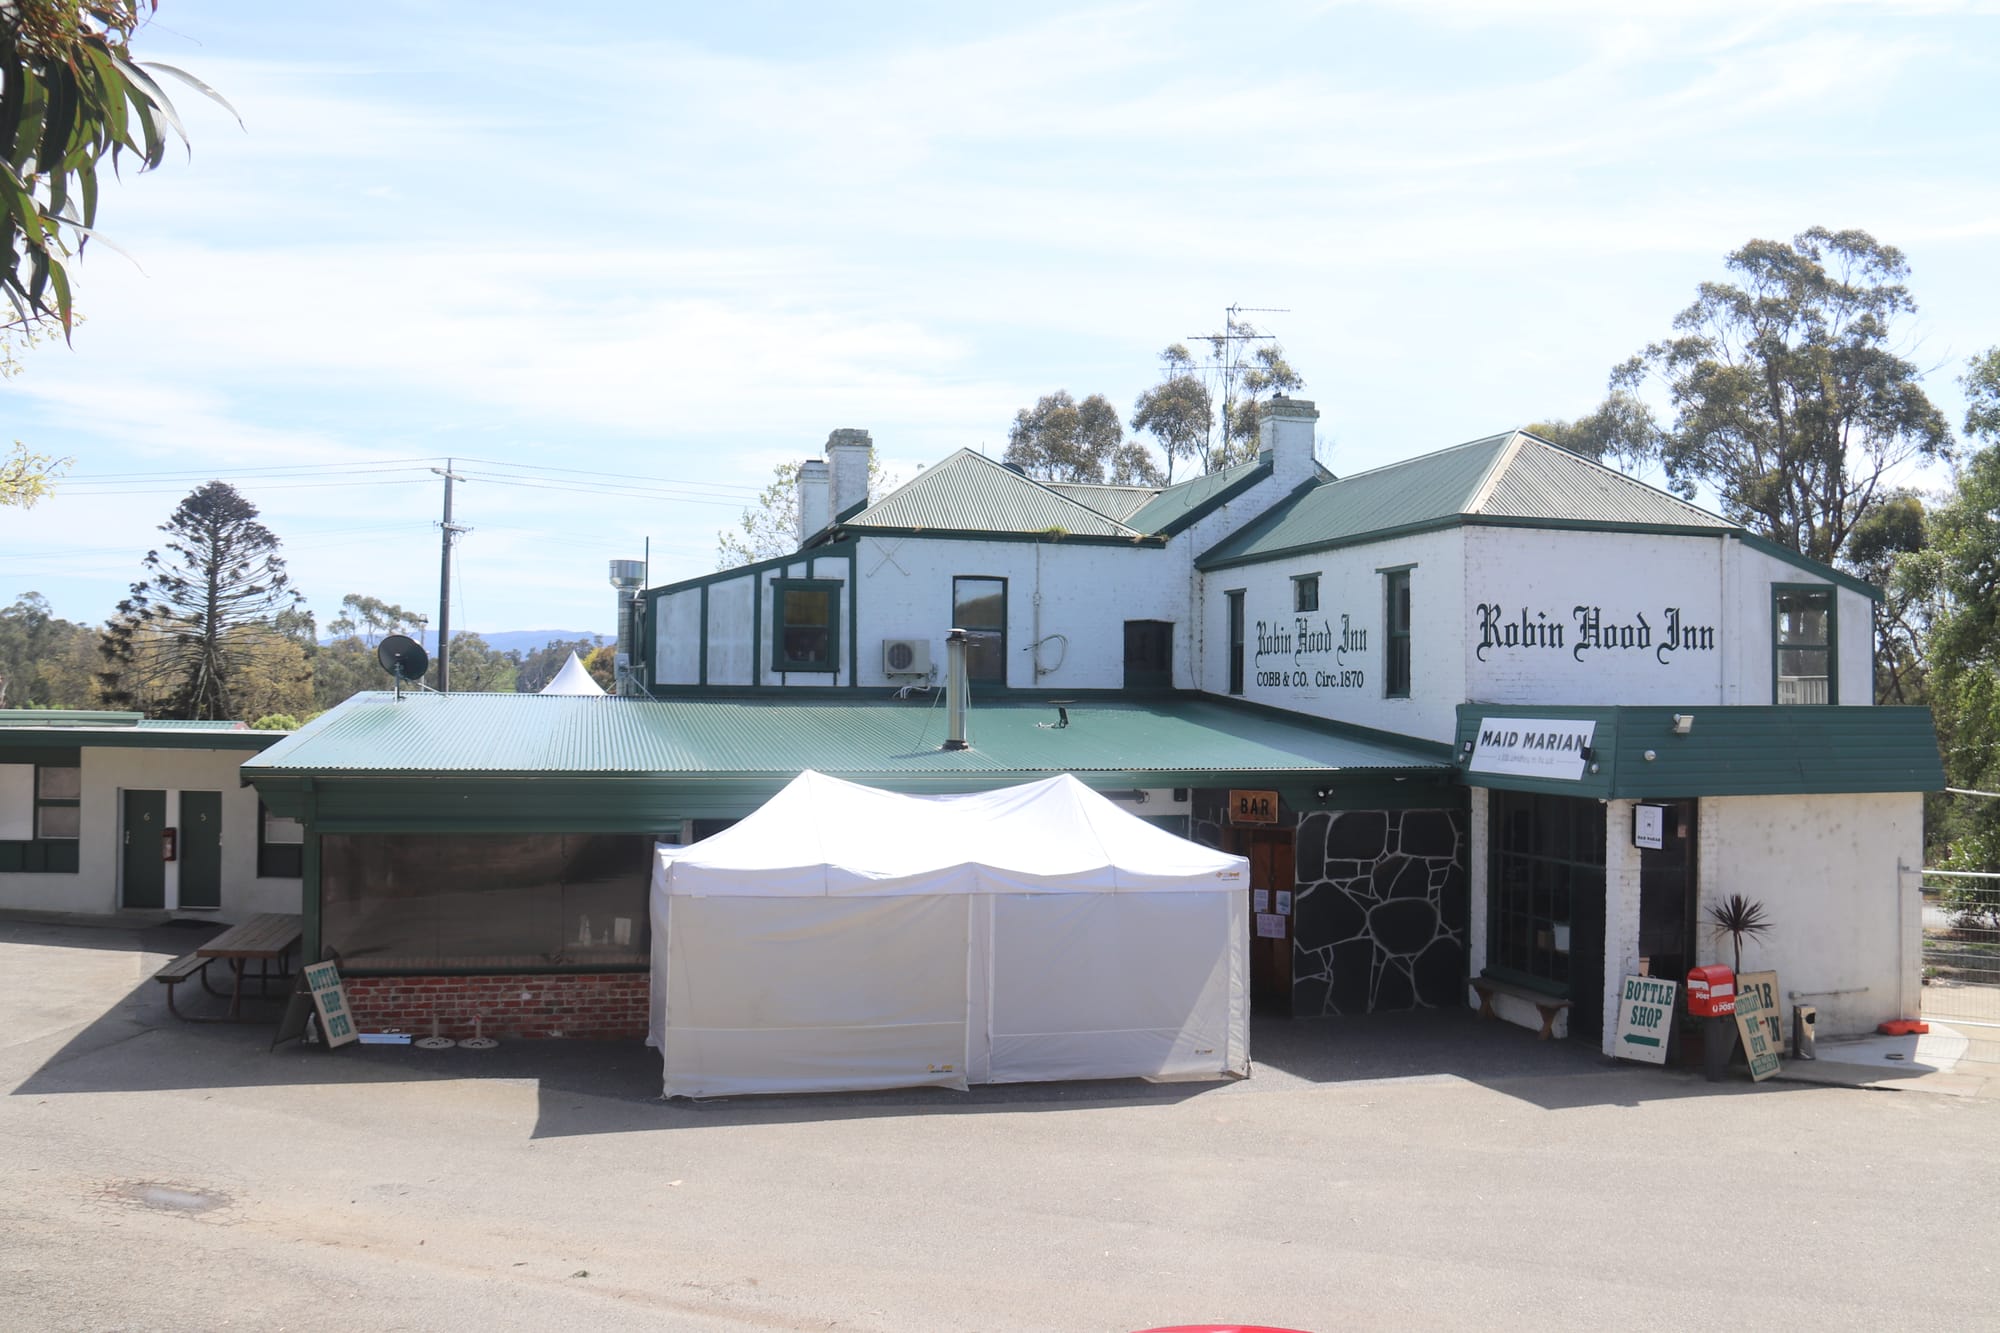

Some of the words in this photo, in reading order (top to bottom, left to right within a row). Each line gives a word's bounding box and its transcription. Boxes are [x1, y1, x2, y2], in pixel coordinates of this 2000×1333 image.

[1254, 620, 1292, 669] Robin
[1294, 617, 1332, 667] Hood
[1336, 613, 1368, 667] Inn
[1475, 602, 1564, 663] Robin
[1572, 605, 1652, 663] Hood
[1656, 607, 1715, 665] Inn
[1256, 671, 1281, 687] COBB
[1282, 671, 1290, 687] &
[1292, 671, 1309, 688] CO.
[1480, 730, 1519, 748] MAID
[1522, 732, 1588, 751] MARIAN
[143, 812, 151, 822] 6
[1240, 797, 1270, 815] BAR
[308, 966, 340, 991] BOTTLE
[321, 990, 342, 1013] SHOP
[1625, 980, 1674, 1006] BOTTLE
[1630, 1005, 1663, 1029] SHOP
[1718, 1001, 1735, 1012] POST
[328, 1014, 351, 1038] OPEN
